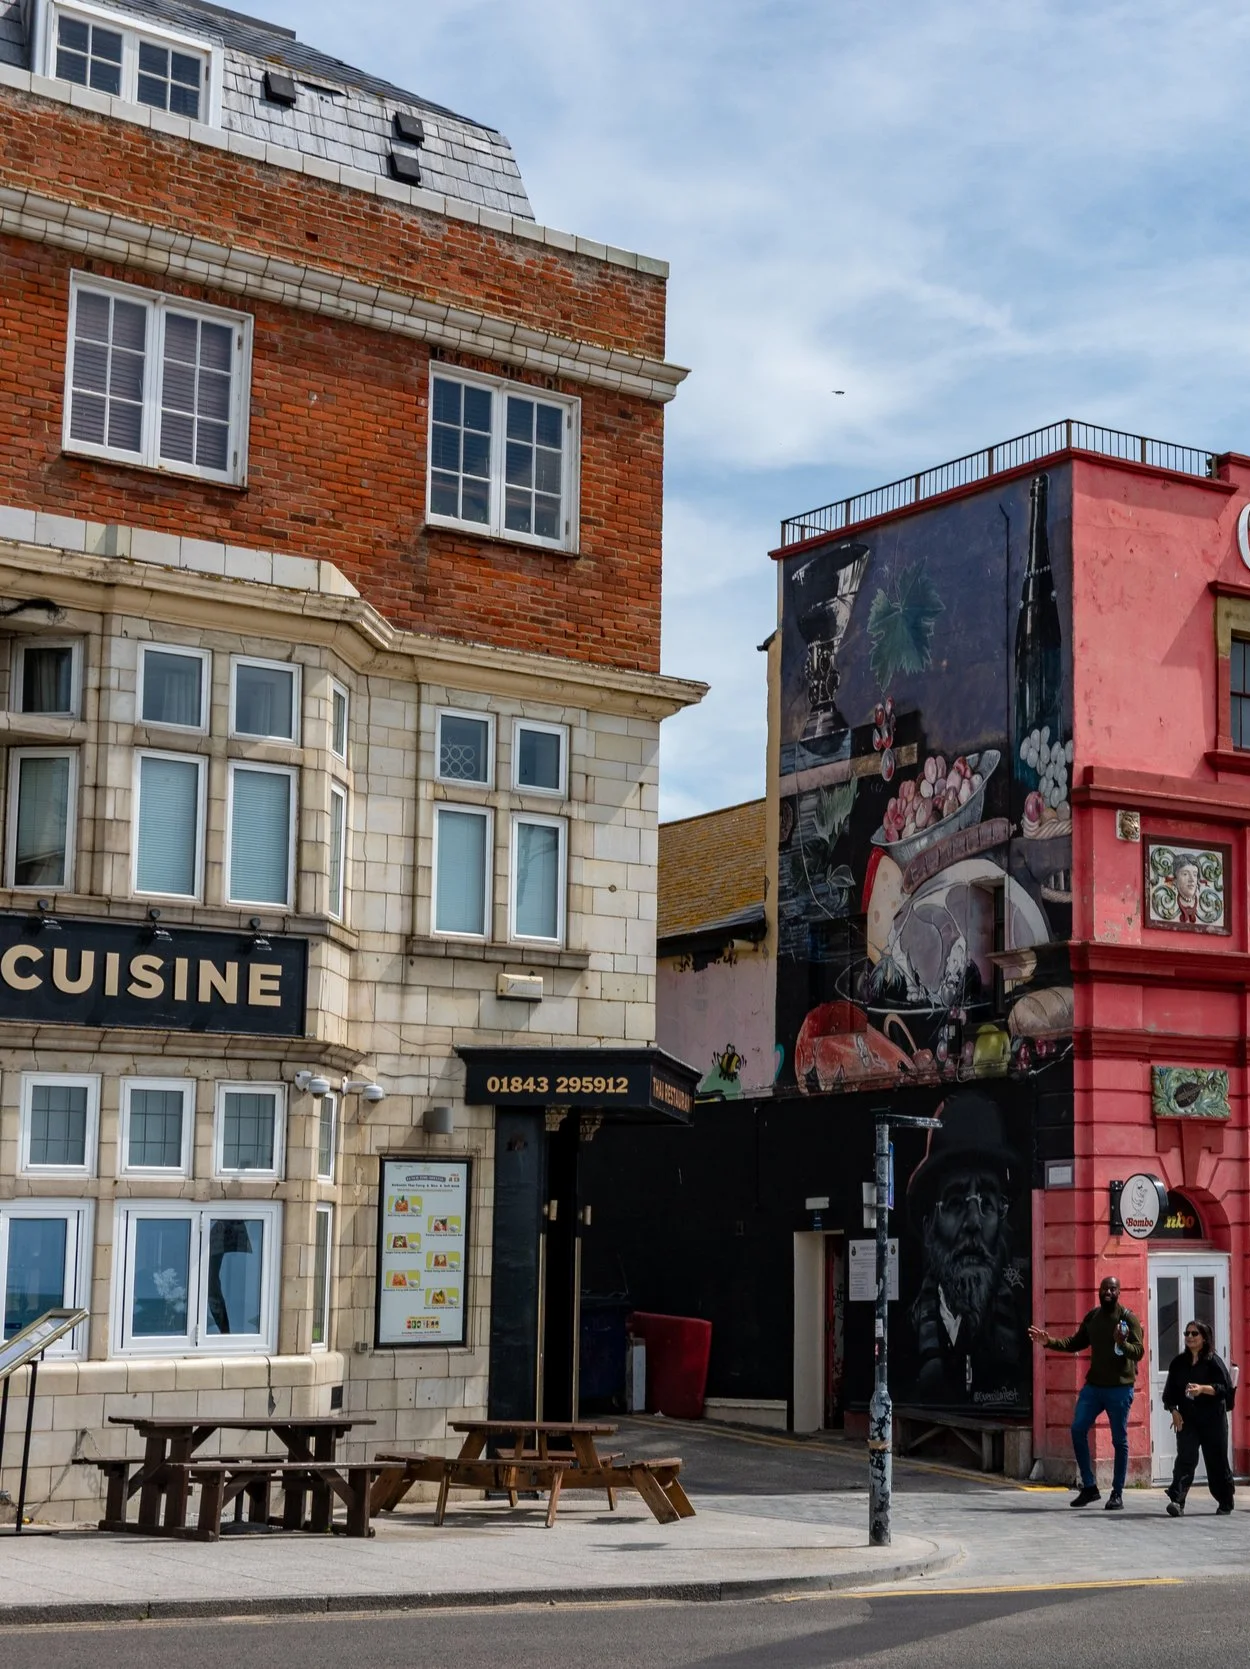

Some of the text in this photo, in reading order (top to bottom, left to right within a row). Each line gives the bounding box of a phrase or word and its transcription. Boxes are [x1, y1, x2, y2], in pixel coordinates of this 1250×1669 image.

[0, 944, 283, 1007] CUISINE
[486, 1076, 629, 1094] 01843 295912
[1126, 1217, 1154, 1228] Bombo
